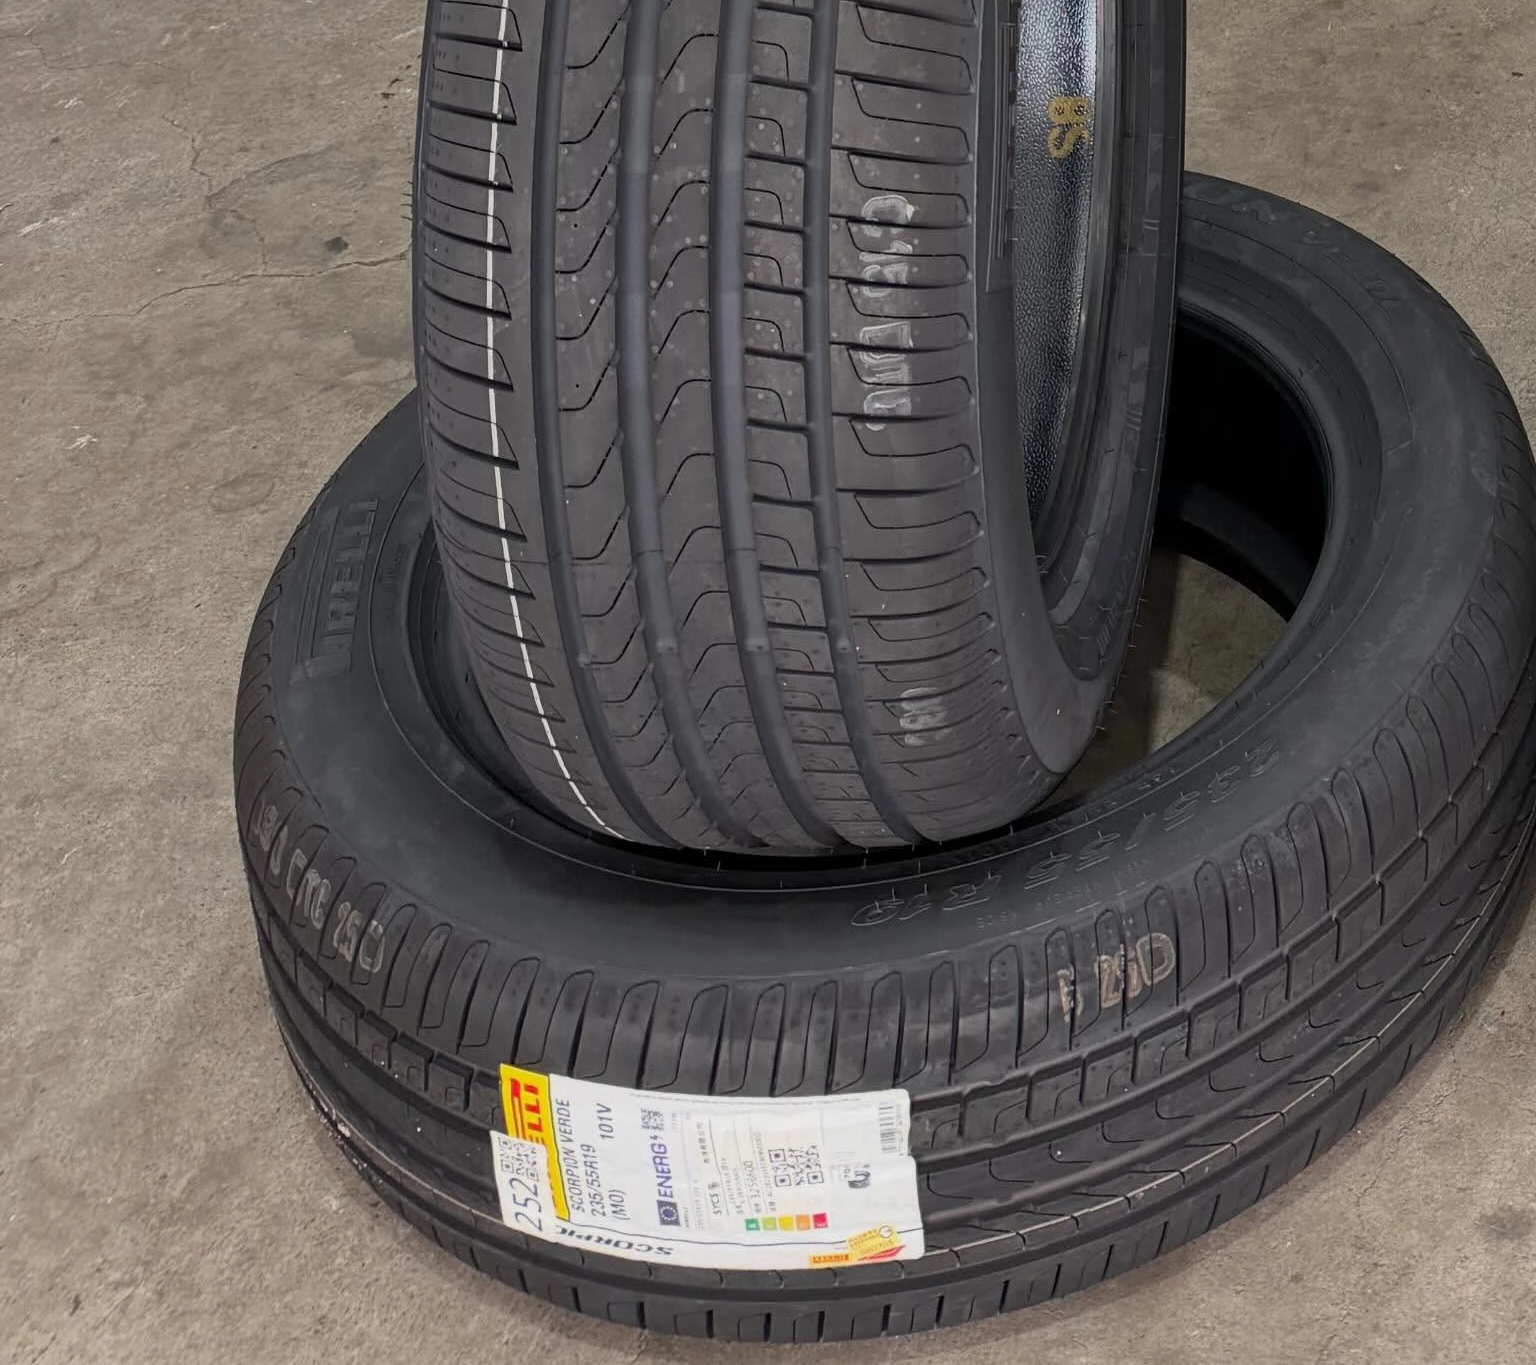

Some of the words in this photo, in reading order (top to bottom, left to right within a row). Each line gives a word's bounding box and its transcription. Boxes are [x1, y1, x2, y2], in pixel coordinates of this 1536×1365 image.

[554, 1098, 574, 1143] VERDE
[596, 1102, 615, 1141] 101V
[562, 1148, 586, 1214] SCORPION
[580, 1143, 607, 1219] 235/55R19
[650, 1142, 674, 1200] ENERG
[508, 1176, 544, 1233] 252
